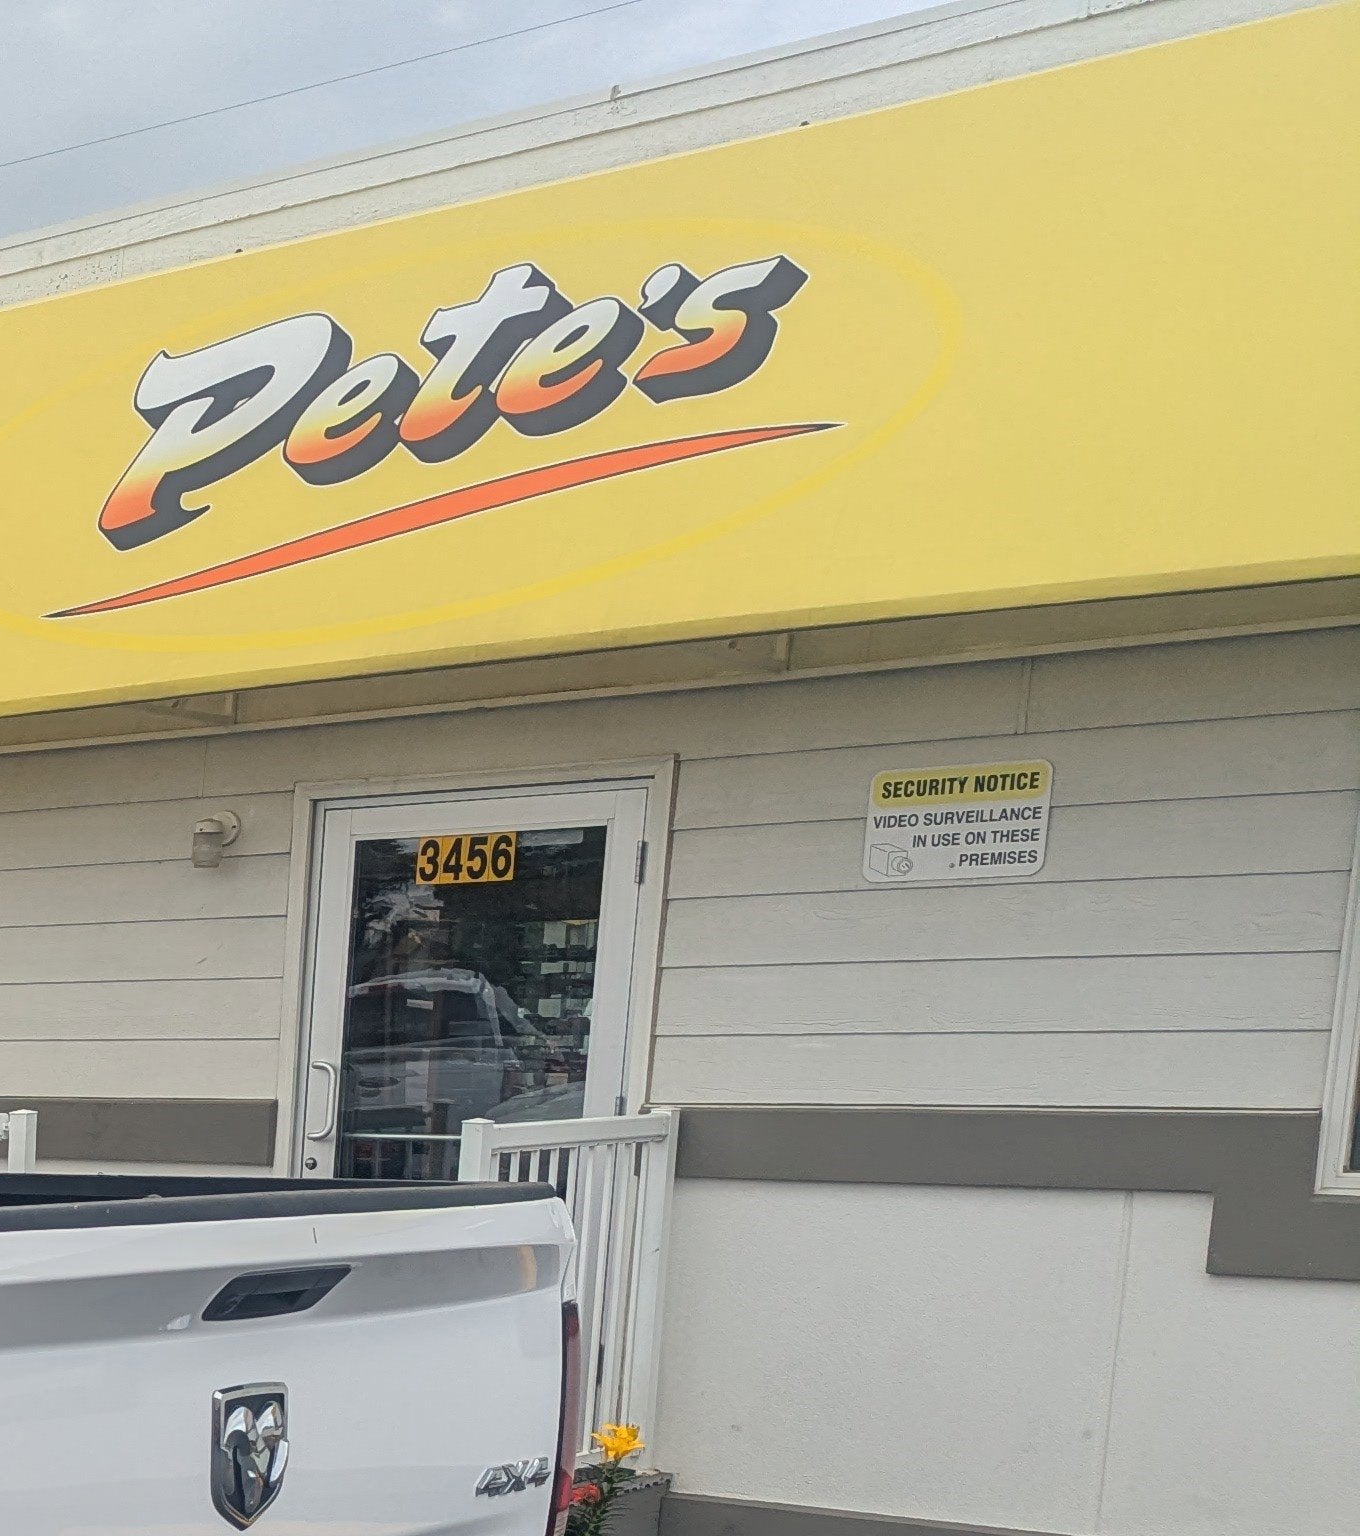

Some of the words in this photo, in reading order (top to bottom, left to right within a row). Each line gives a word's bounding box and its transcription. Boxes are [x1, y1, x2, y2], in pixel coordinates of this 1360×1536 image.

[98, 254, 809, 551] Pete's
[881, 776, 968, 799] SECURITY
[973, 771, 1040, 793] NOTICE
[873, 813, 919, 829] VIDEO
[923, 806, 1043, 826] SURVEILLANCE
[912, 834, 927, 848] IN
[931, 833, 960, 847] USE
[964, 831, 986, 845] ON
[991, 828, 1040, 843] THESE
[417, 833, 514, 882] 3456
[958, 849, 1038, 867] PREMISES
